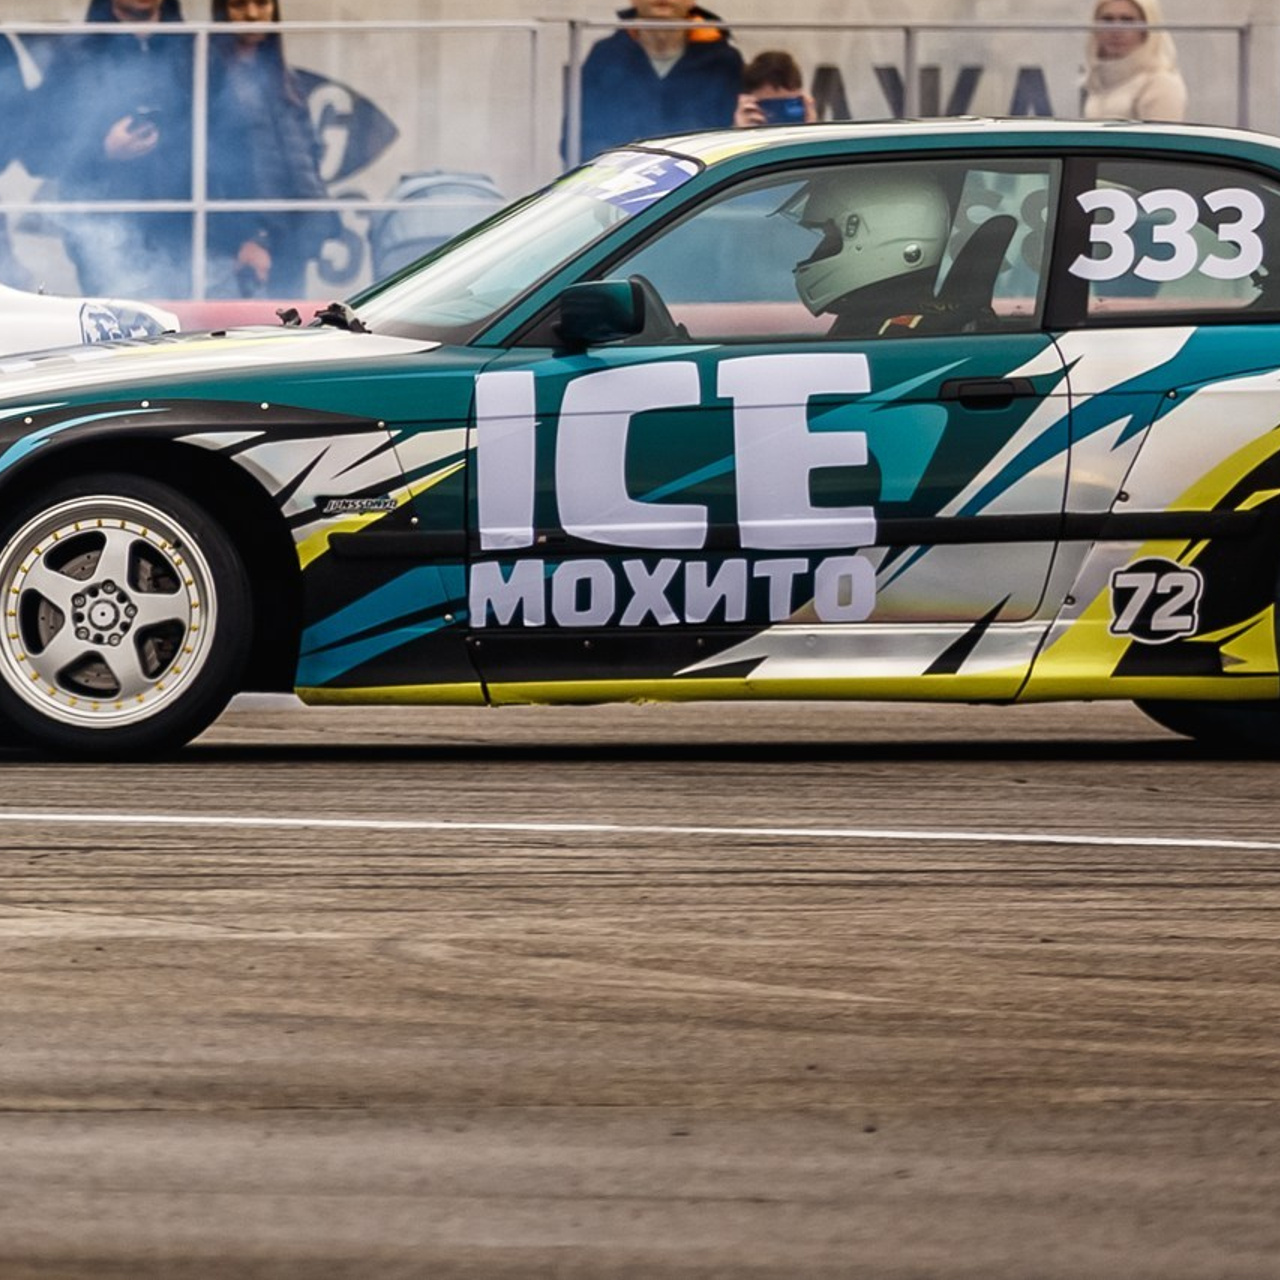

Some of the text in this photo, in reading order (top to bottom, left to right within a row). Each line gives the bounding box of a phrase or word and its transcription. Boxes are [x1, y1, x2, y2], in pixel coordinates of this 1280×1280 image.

[1068, 187, 1265, 281] 333
[475, 353, 877, 550] ICE
[469, 555, 877, 627] МОХИТО
[1113, 572, 1199, 631] 72
